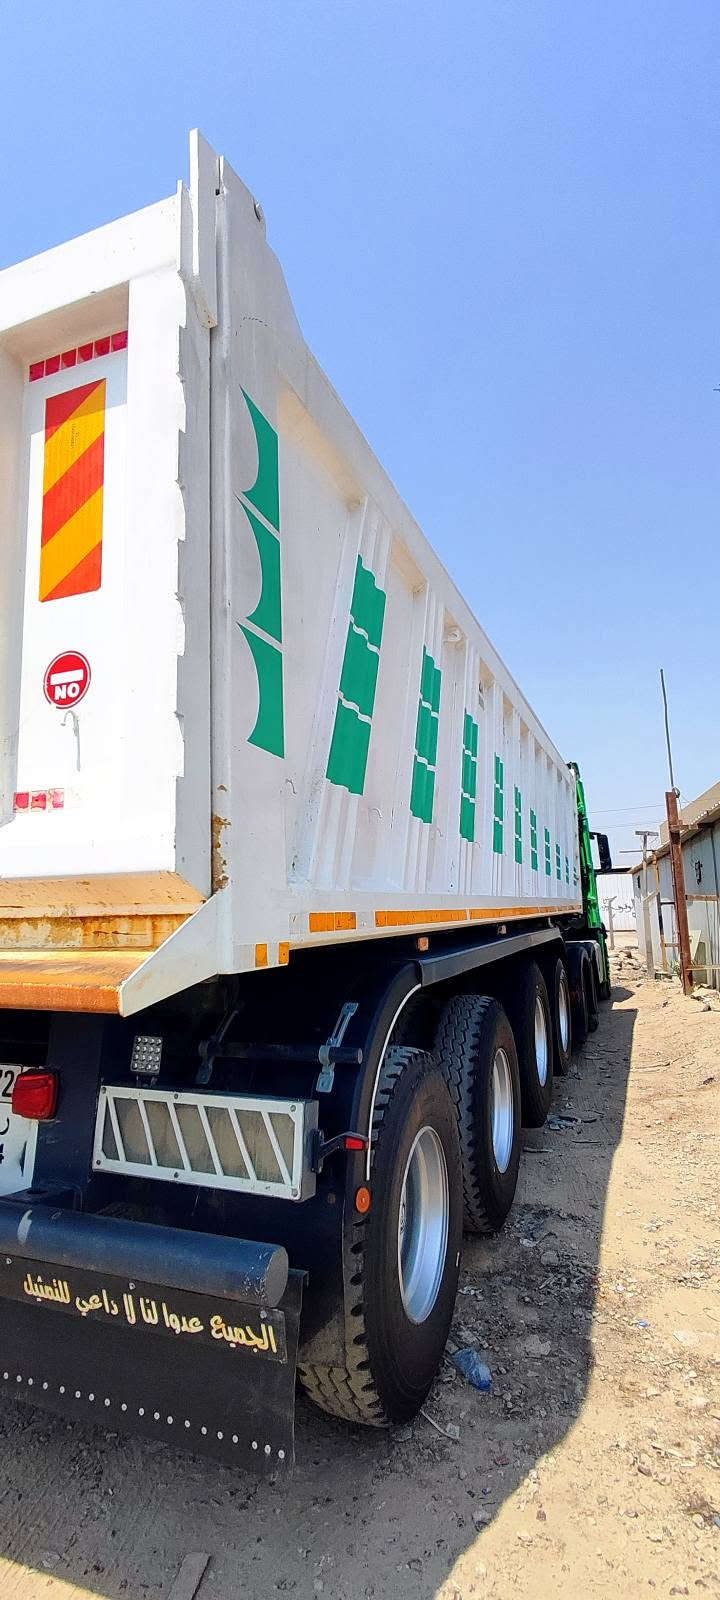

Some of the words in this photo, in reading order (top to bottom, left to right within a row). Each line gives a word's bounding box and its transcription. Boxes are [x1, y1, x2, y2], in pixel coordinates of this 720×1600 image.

[54, 682, 80, 701] NO
[0, 1070, 14, 1098] 2
[24, 1274, 71, 1304] للتمثيل
[76, 1289, 118, 1316] داعي
[123, 1293, 136, 1325] لا
[139, 1297, 158, 1325] لنا
[162, 1303, 203, 1334] عدوا
[210, 1316, 277, 1353] الجميع
